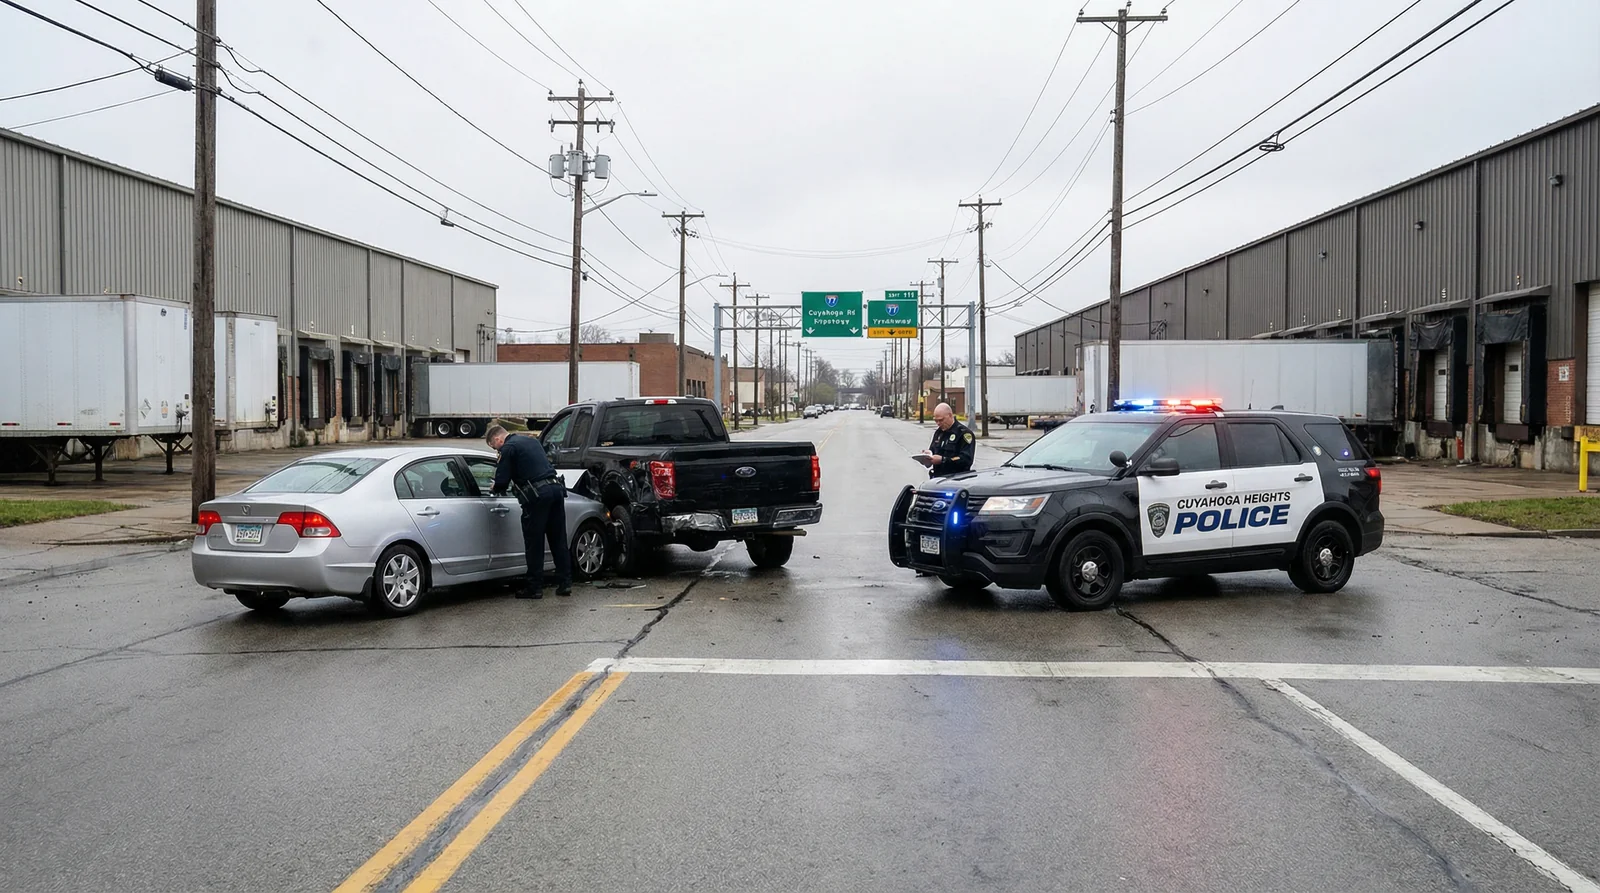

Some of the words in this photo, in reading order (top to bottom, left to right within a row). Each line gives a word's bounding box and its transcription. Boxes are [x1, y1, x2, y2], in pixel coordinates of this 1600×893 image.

[1177, 496, 1241, 510] CUYAHOGA
[1243, 491, 1291, 504] HEIGHTS
[1173, 504, 1291, 535] POLICE
